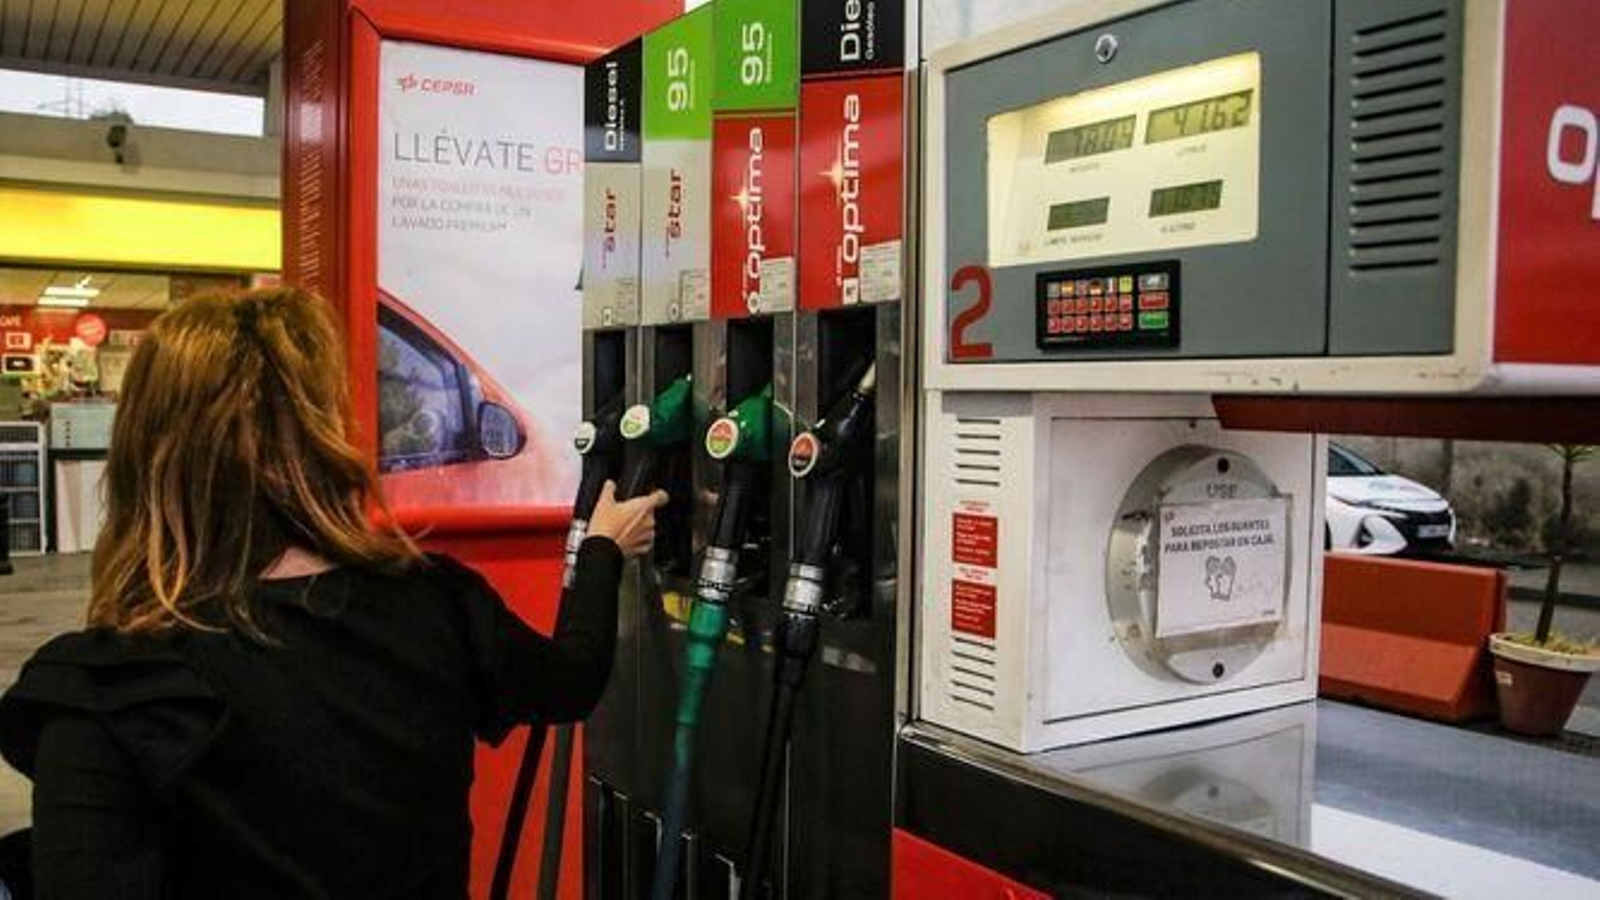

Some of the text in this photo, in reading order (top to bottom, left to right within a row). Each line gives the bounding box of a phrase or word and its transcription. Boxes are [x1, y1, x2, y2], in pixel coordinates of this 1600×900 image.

[668, 48, 688, 111] 95
[742, 22, 763, 85] 95
[605, 61, 618, 151] Diesel
[394, 128, 535, 172] LLÉVATE
[842, 94, 864, 263] optima
[1547, 104, 1600, 220] o
[392, 216, 443, 230] LAVADO
[421, 198, 438, 211] LA
[606, 188, 617, 251] star
[670, 170, 682, 239] star
[747, 128, 765, 279] optima
[951, 265, 993, 357] 2
[1165, 541, 1188, 553] PARA
[1191, 538, 1236, 552] REPOSTAR
[1238, 537, 1250, 547] EN
[1171, 524, 1211, 537] SOLICITA
